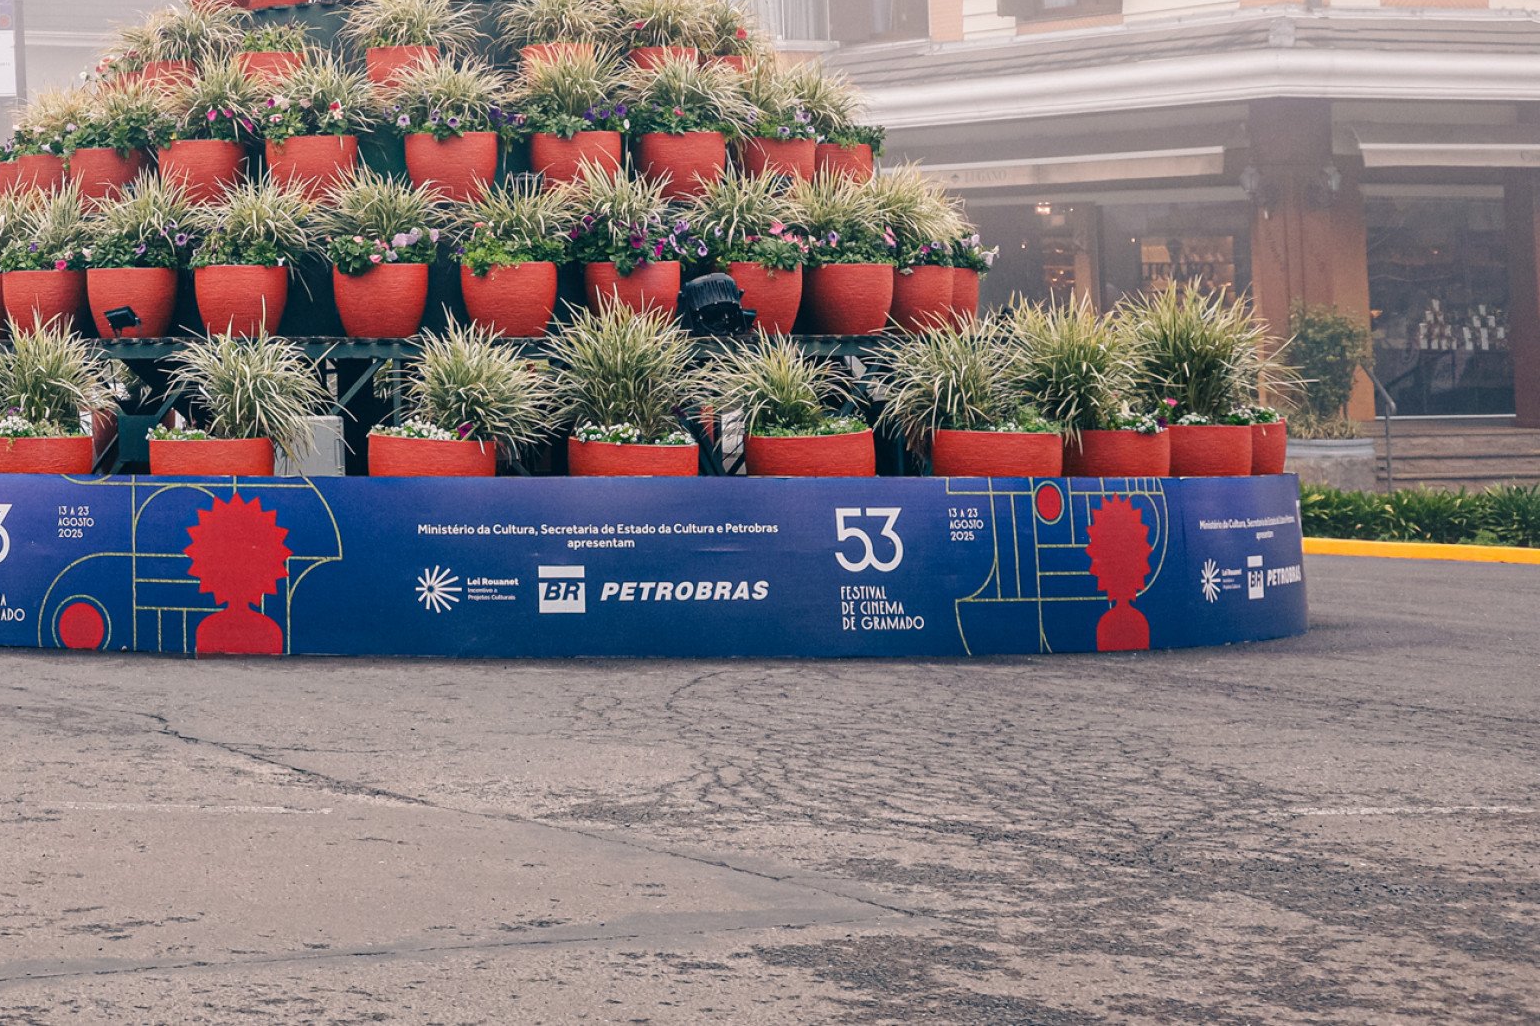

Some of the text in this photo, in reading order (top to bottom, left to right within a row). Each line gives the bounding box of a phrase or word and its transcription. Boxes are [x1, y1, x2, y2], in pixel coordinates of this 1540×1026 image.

[59, 506, 89, 516] 13 A 23
[949, 508, 978, 518] 13 A 23
[58, 517, 95, 527] AGOSTO
[950, 519, 984, 530] AGOSTO
[58, 529, 84, 538] 2025
[417, 524, 475, 534] Ministério
[477, 524, 491, 534] da
[493, 524, 539, 536] Cultura,
[541, 524, 598, 534] Secretaria
[601, 524, 615, 534] de
[617, 524, 656, 534] Estado
[658, 524, 671, 534] da
[674, 523, 714, 533] Cultura
[725, 523, 778, 533] Petrobras
[835, 507, 904, 572] 53
[951, 531, 975, 541] 2025
[567, 538, 635, 550] apresentam
[467, 577, 519, 586] Lei Rouanet
[544, 580, 770, 602] BR PETROBRAS
[840, 586, 887, 600] FESTIVAL
[842, 601, 905, 615] DE CINEMA
[843, 616, 925, 631] DE GRAMADO
